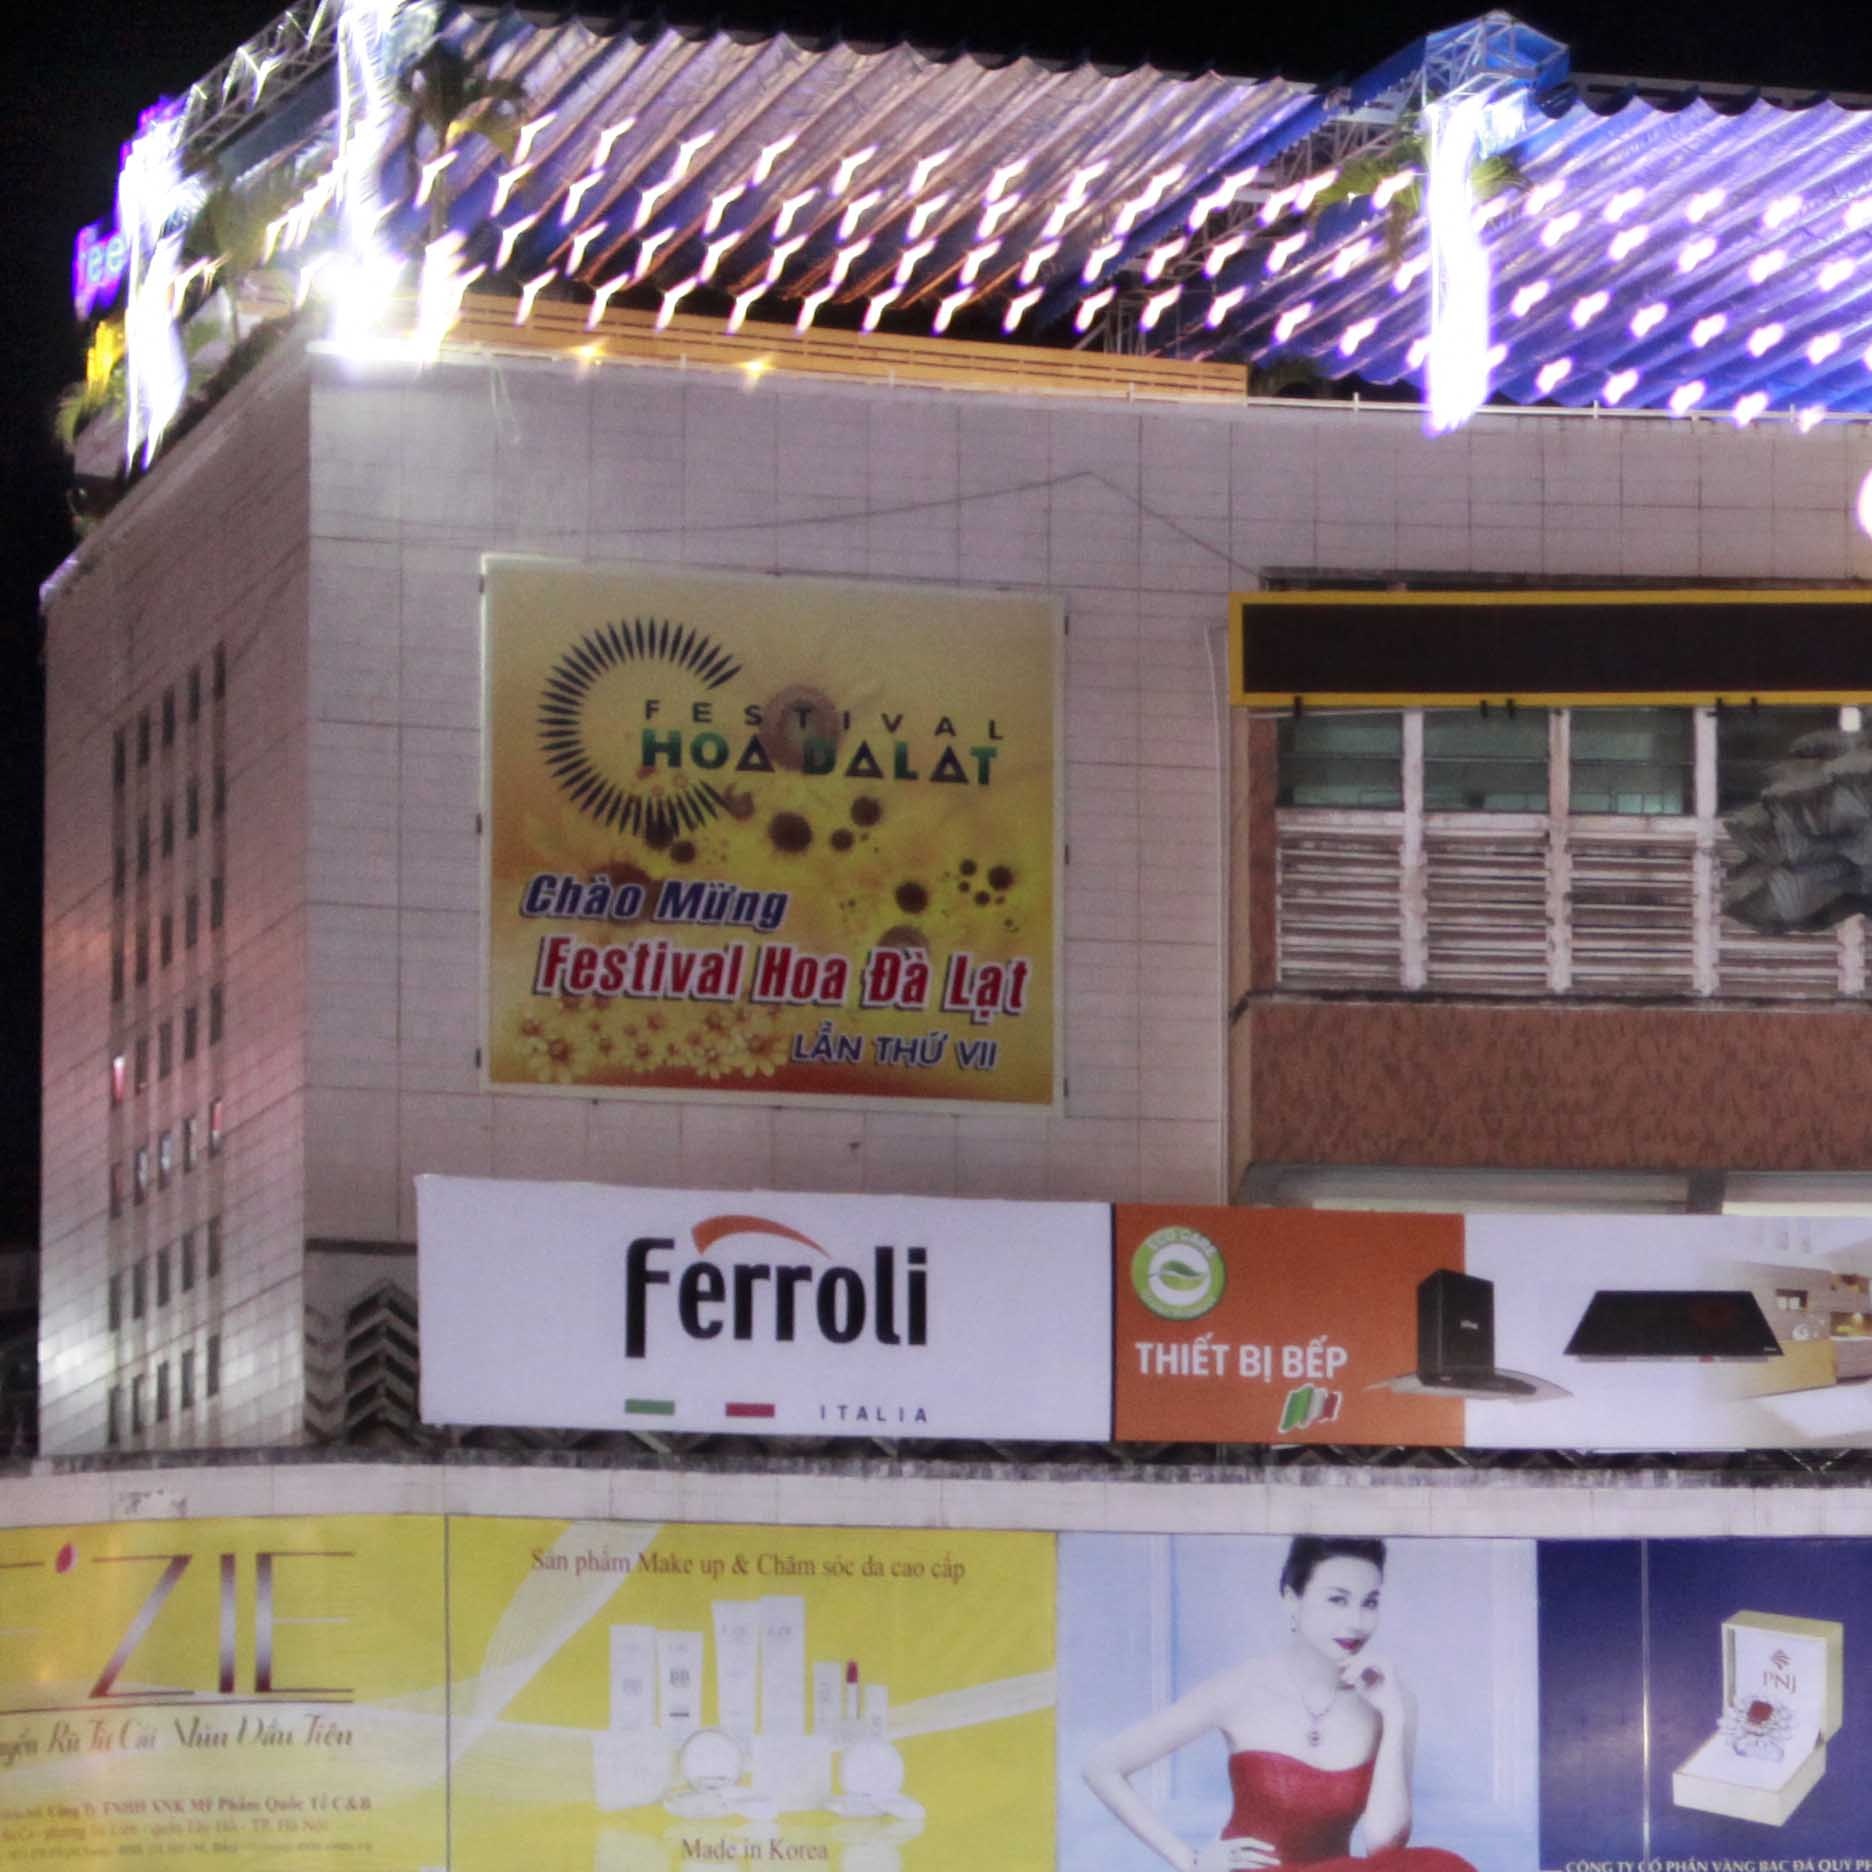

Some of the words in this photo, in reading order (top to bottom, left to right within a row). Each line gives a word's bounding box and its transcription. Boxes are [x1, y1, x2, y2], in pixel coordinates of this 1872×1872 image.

[645, 699, 1003, 742] FESTIVAL
[641, 728, 775, 774] HOA
[522, 872, 645, 923] Chào
[657, 877, 789, 931] Mừng
[537, 936, 745, 996] Festival
[753, 943, 849, 1002] Hoa
[863, 943, 930, 1007] Đà
[944, 953, 1030, 1021] Lạt
[791, 1022, 863, 1065] LẦN
[873, 1031, 949, 1068] THỨ
[956, 1039, 998, 1069] VII
[625, 1237, 928, 1358] Ferroli
[1135, 1332, 1230, 1376] THIẾT
[1238, 1344, 1273, 1384] BỊ
[1282, 1334, 1348, 1380] BẾP
[820, 1405, 929, 1423] ITALIA
[638, 1552, 694, 1574] Make
[701, 1556, 725, 1583] up
[891, 1559, 926, 1578] cao
[1762, 1670, 1797, 1695] PNJ
[681, 1838, 736, 1861] Made
[744, 1839, 762, 1861] in
[770, 1838, 829, 1861] Korea
[1792, 1856, 1815, 1872] ĐÁ
